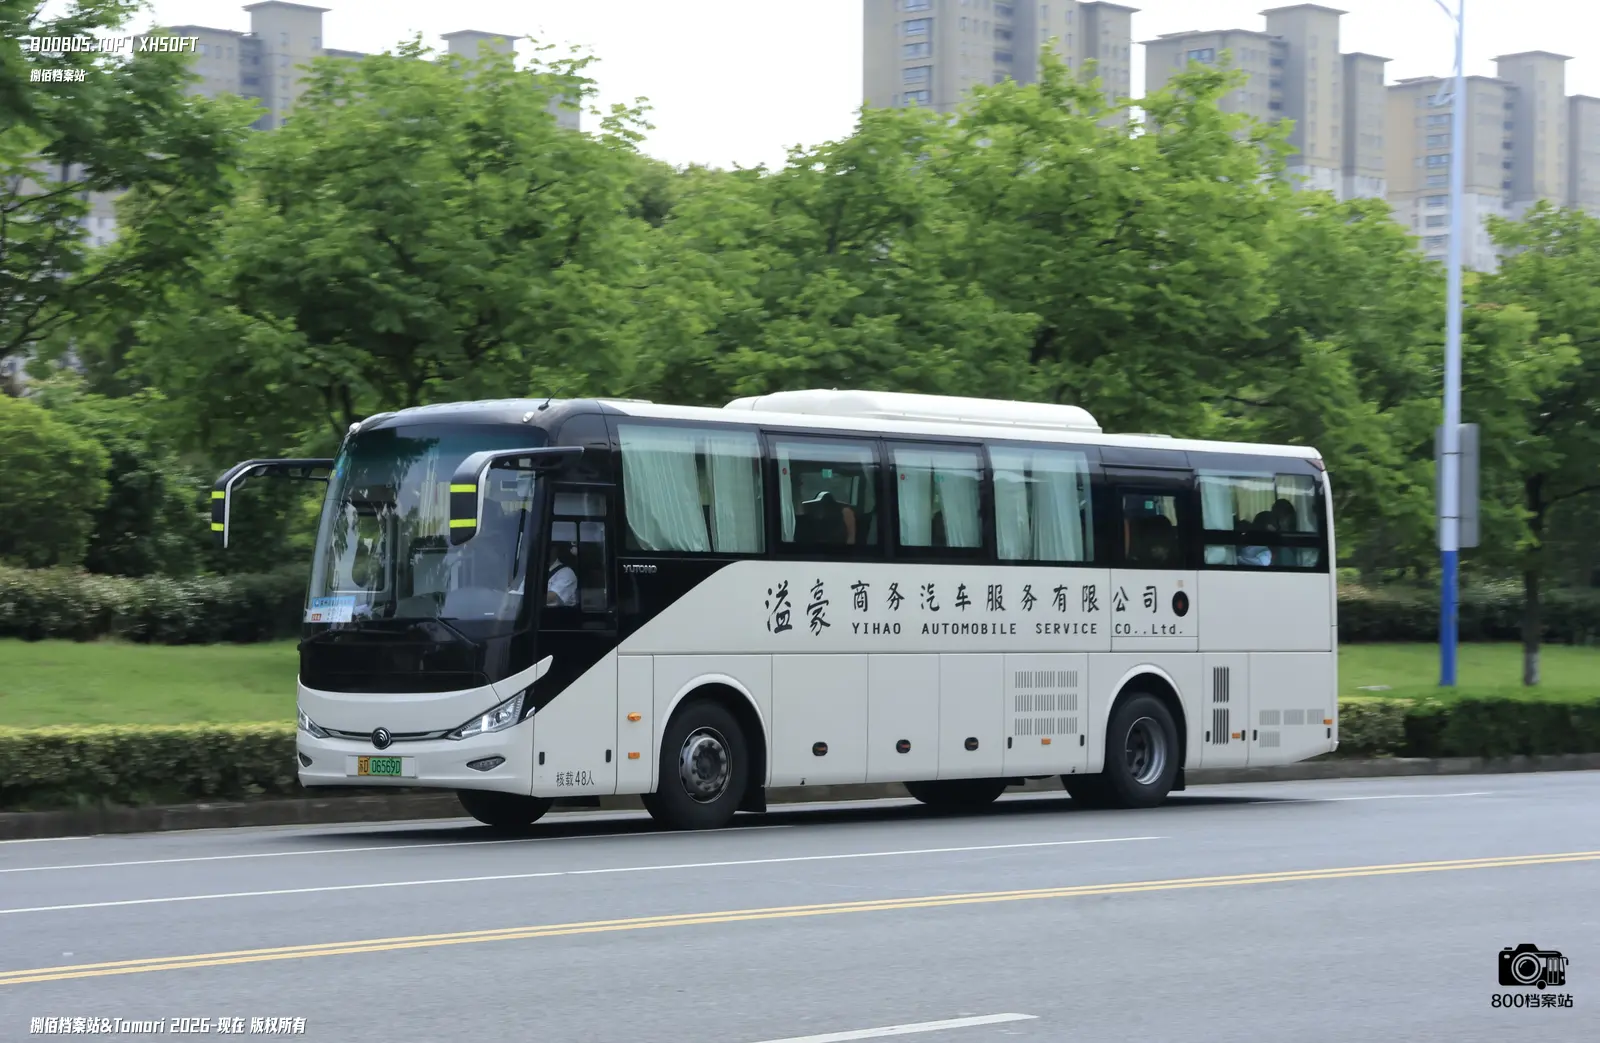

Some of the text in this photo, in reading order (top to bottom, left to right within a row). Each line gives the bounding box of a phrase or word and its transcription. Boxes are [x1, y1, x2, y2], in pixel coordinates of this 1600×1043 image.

[852, 622, 901, 635] YIHAO
[921, 622, 1017, 635] AUTOMOBILE
[1035, 623, 1098, 635] SERVICE
[556, 770, 595, 787] 核载48人
